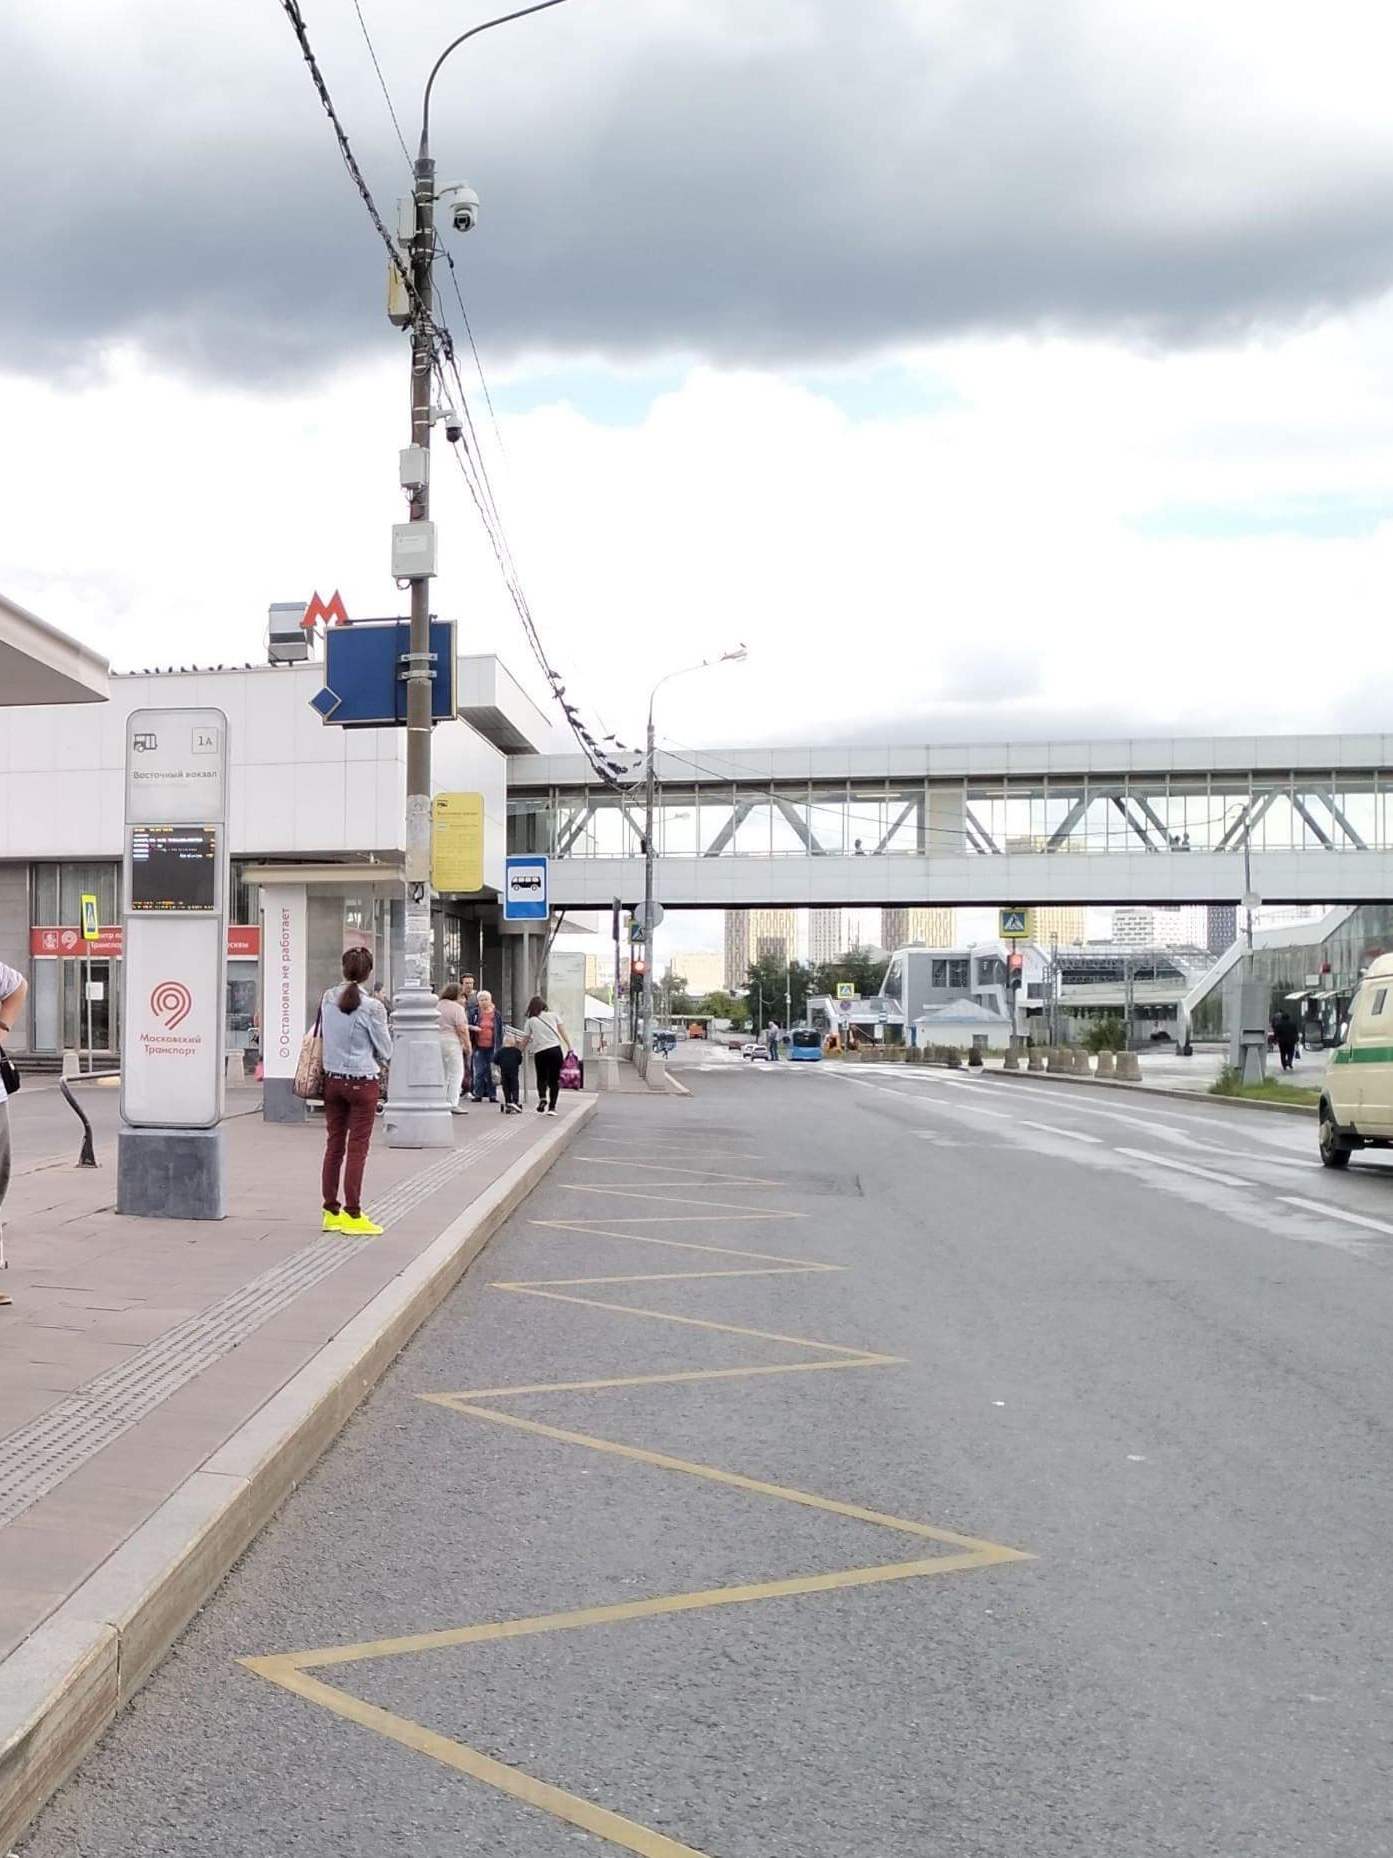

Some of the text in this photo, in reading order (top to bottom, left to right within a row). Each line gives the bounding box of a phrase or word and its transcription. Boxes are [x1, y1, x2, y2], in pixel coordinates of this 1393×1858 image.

[279, 907, 292, 1045] Остановка не работает
[139, 1033, 202, 1044] Московский
[144, 1045, 196, 1057] Транспорт
